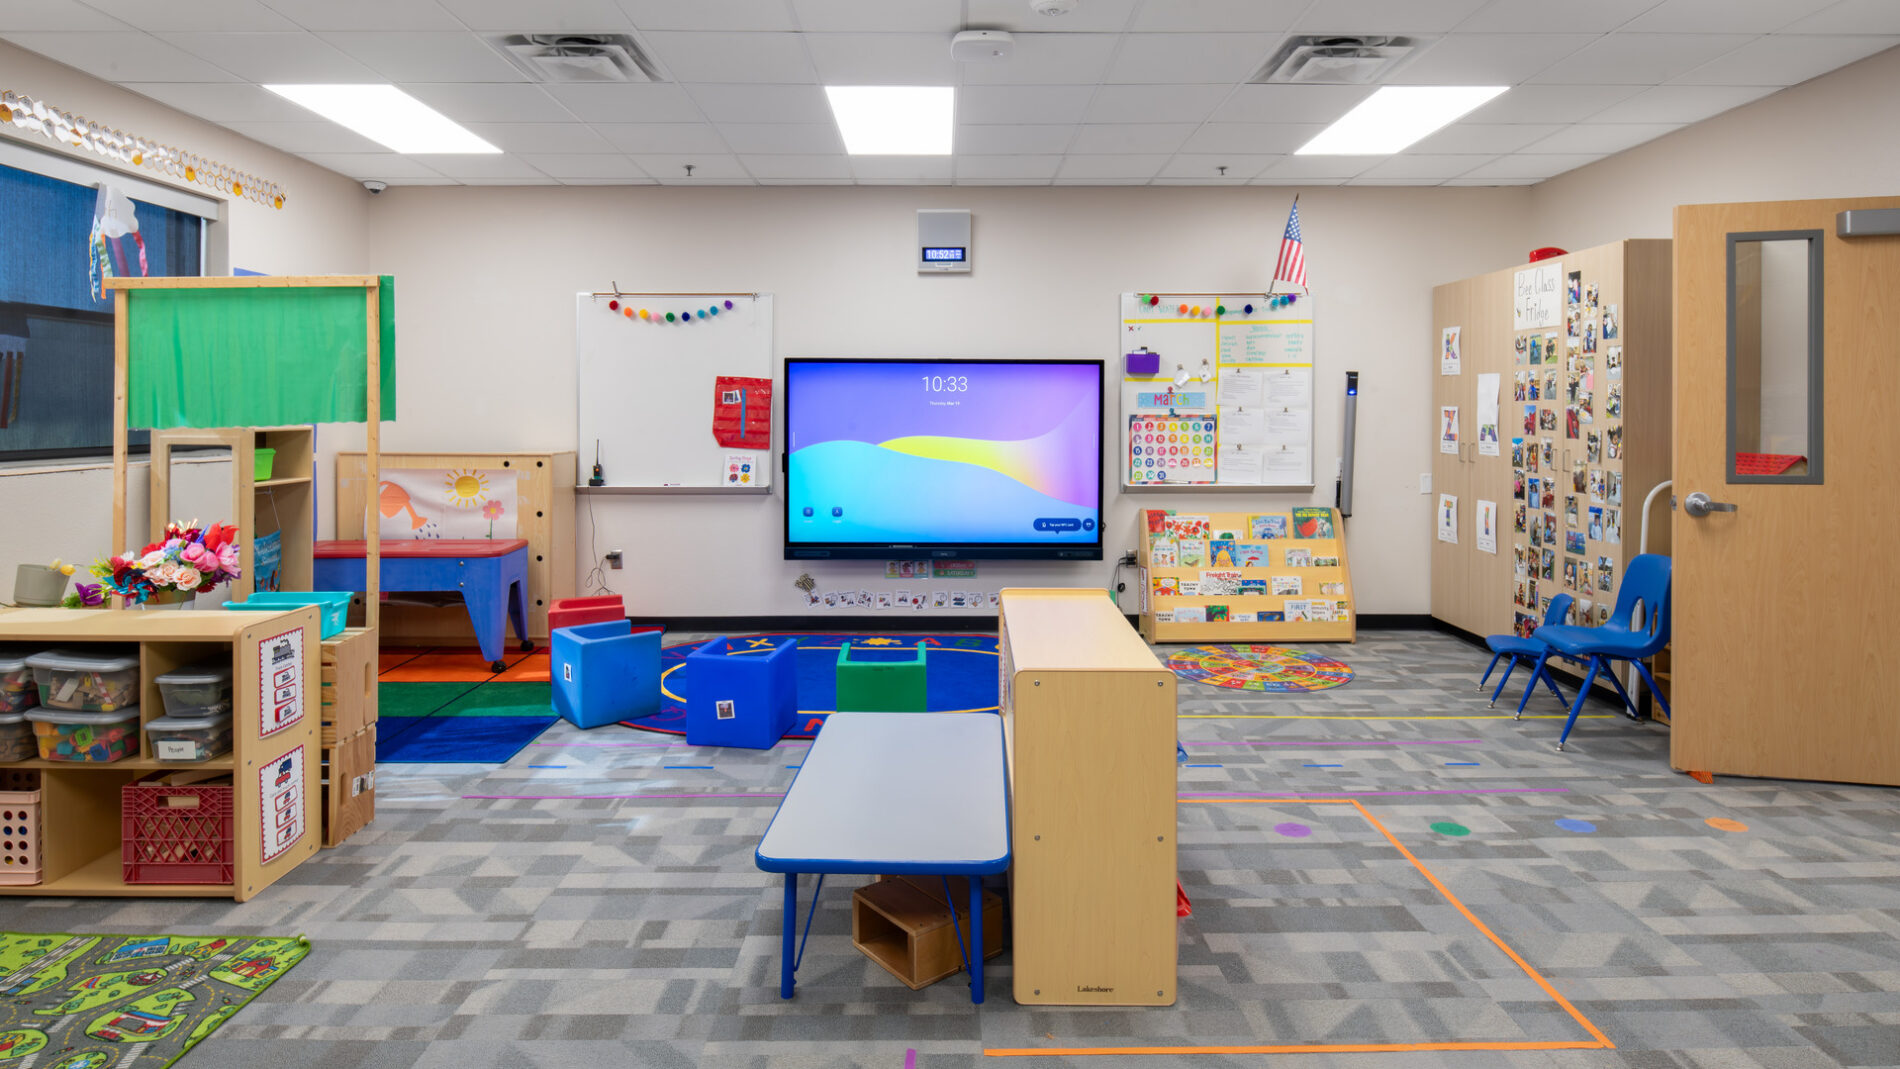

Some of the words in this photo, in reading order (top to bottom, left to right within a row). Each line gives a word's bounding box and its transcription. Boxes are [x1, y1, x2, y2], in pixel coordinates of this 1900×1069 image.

[927, 250, 949, 259] 10:52
[1535, 268, 1555, 294] Class
[922, 376, 968, 392] 10:33
[1153, 393, 1190, 406] March
